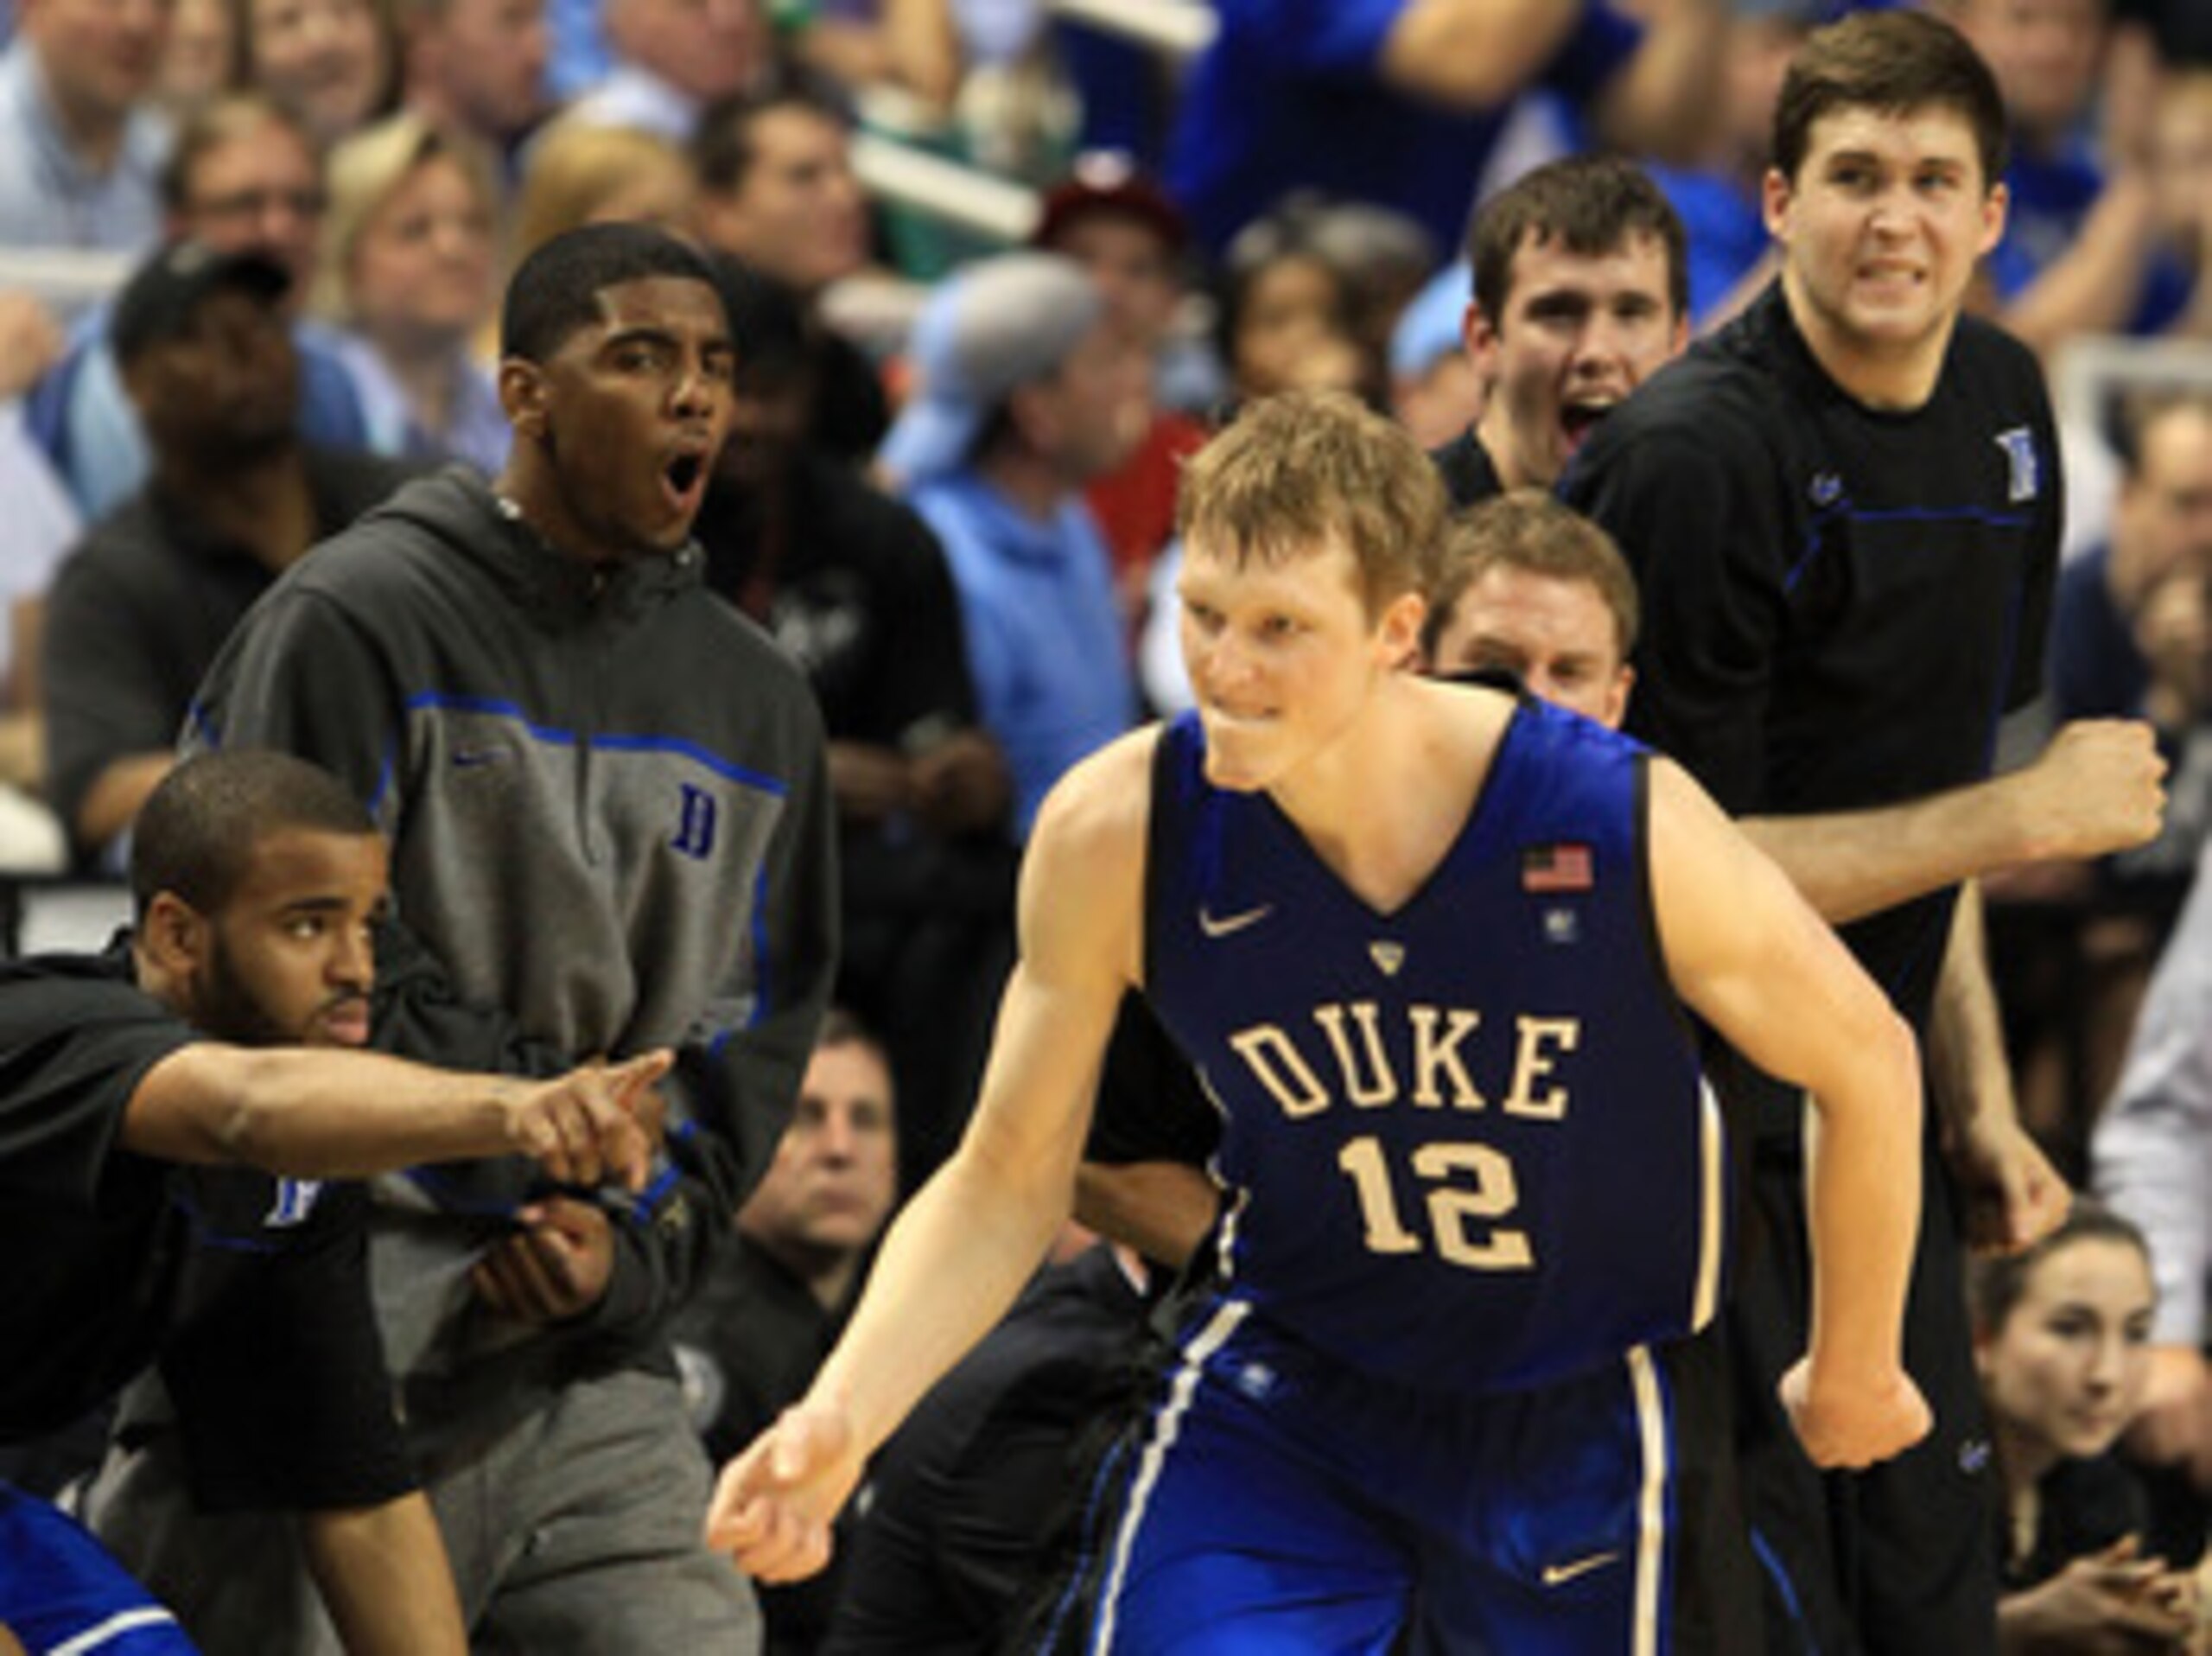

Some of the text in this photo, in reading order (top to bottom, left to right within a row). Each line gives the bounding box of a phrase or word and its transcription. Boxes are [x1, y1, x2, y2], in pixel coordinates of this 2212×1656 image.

[670, 781, 716, 861] D
[1229, 1001, 1580, 1119] DUKE
[1338, 1136, 1534, 1270] 12
